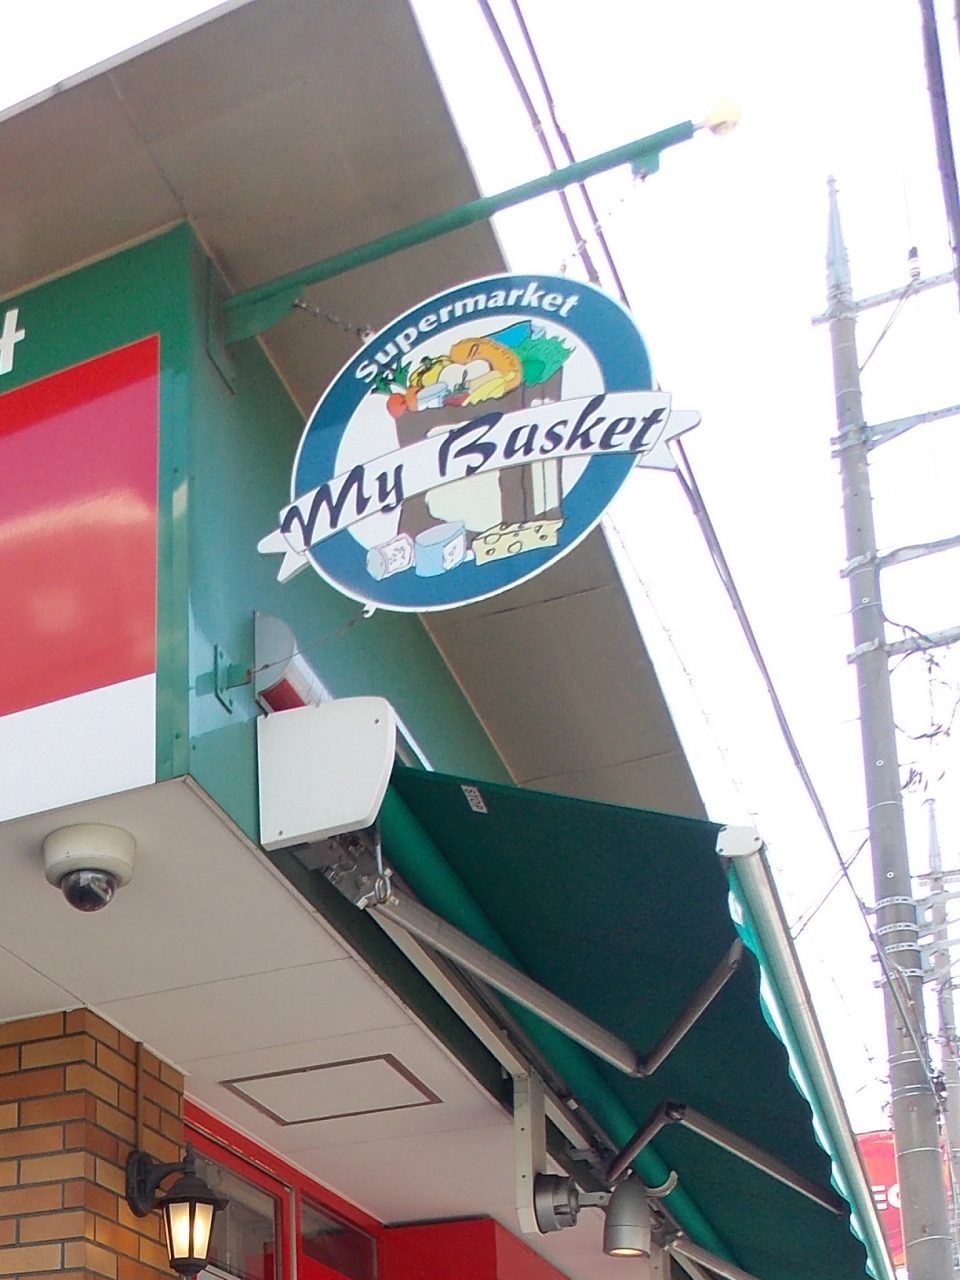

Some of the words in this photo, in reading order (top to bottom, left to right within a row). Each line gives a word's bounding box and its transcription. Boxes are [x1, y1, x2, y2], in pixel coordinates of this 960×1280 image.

[356, 282, 579, 383] Supermarket
[280, 464, 404, 547] My
[439, 394, 667, 477] Basket
